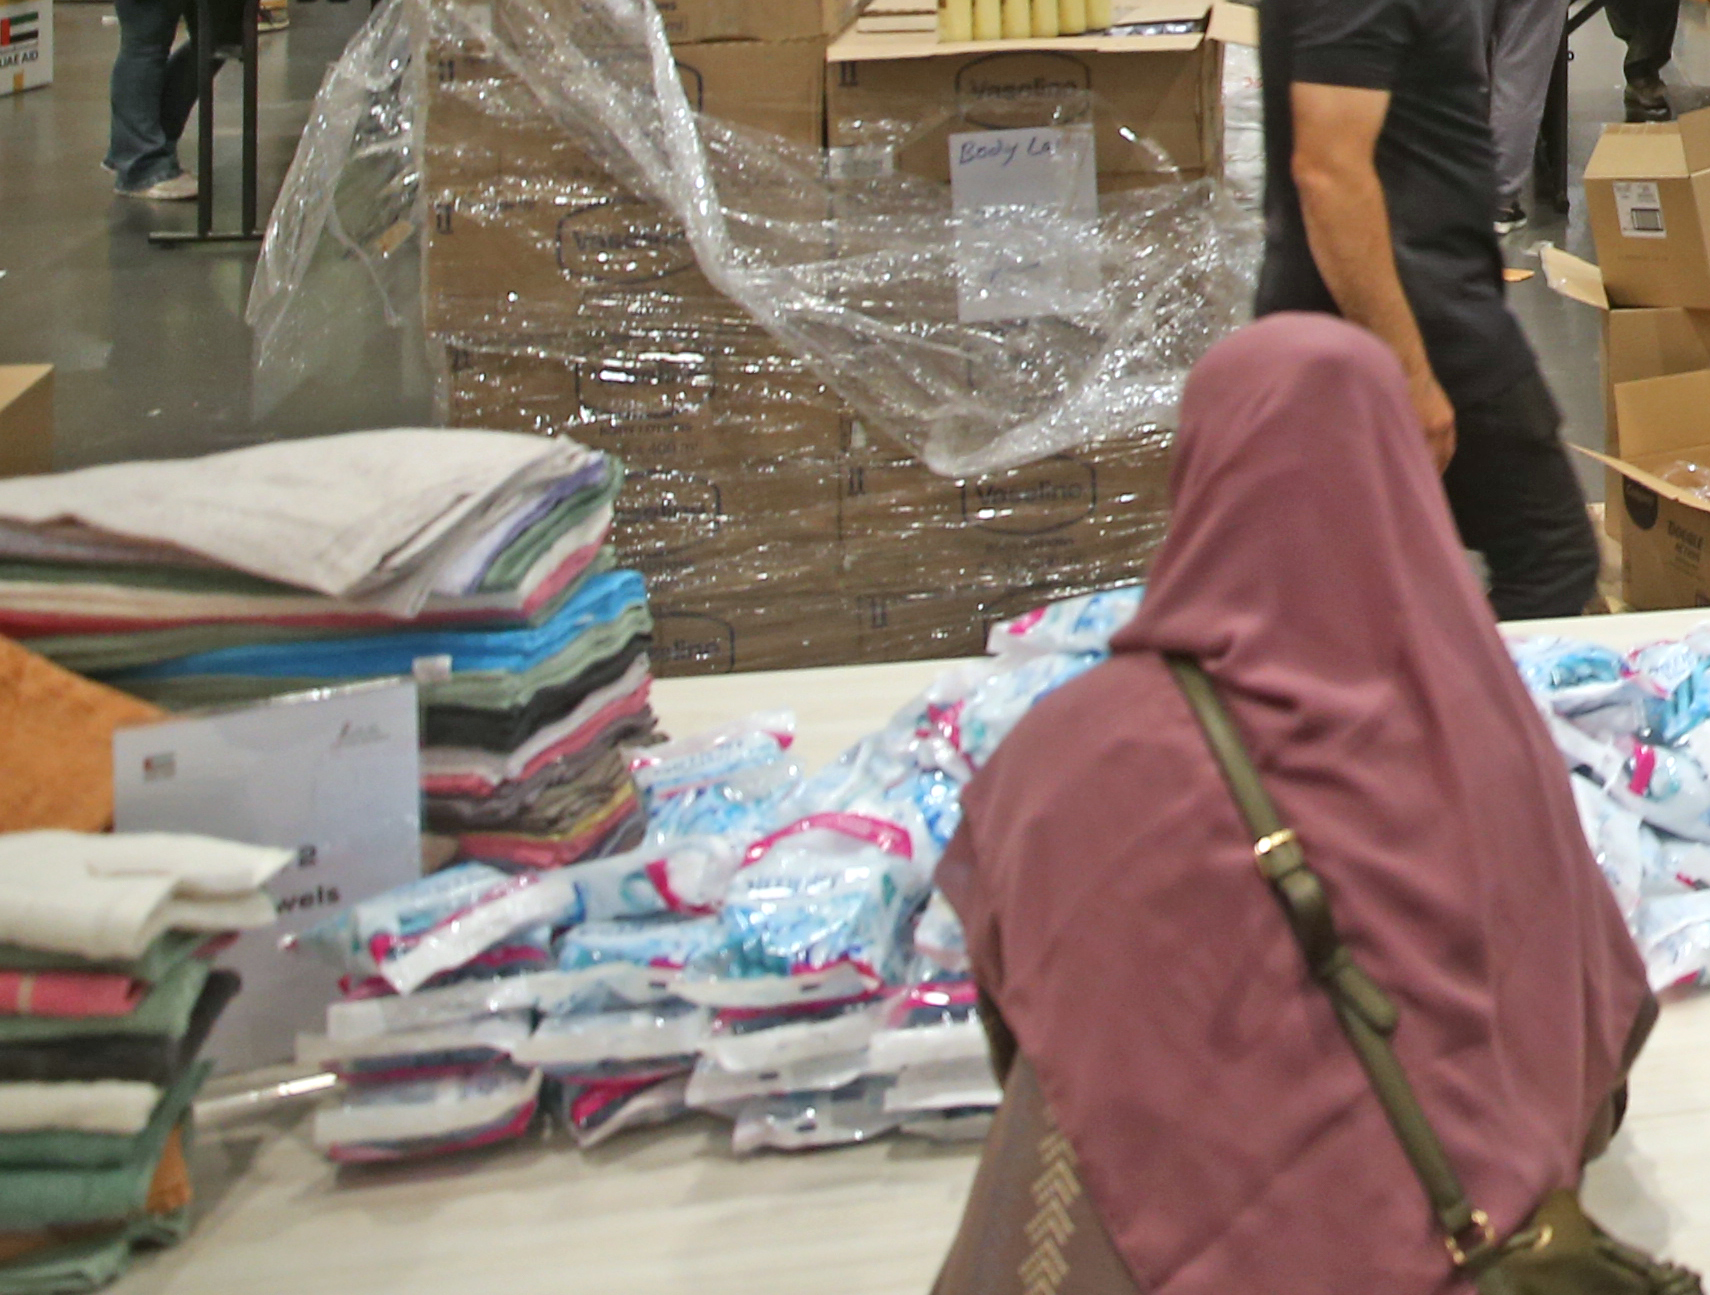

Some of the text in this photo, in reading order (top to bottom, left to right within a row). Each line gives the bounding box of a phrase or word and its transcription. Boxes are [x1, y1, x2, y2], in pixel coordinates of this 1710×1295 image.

[22, 51, 39, 62] AID
[959, 139, 1018, 167] Body
[298, 844, 317, 867] 2
[276, 885, 341, 914] wels
